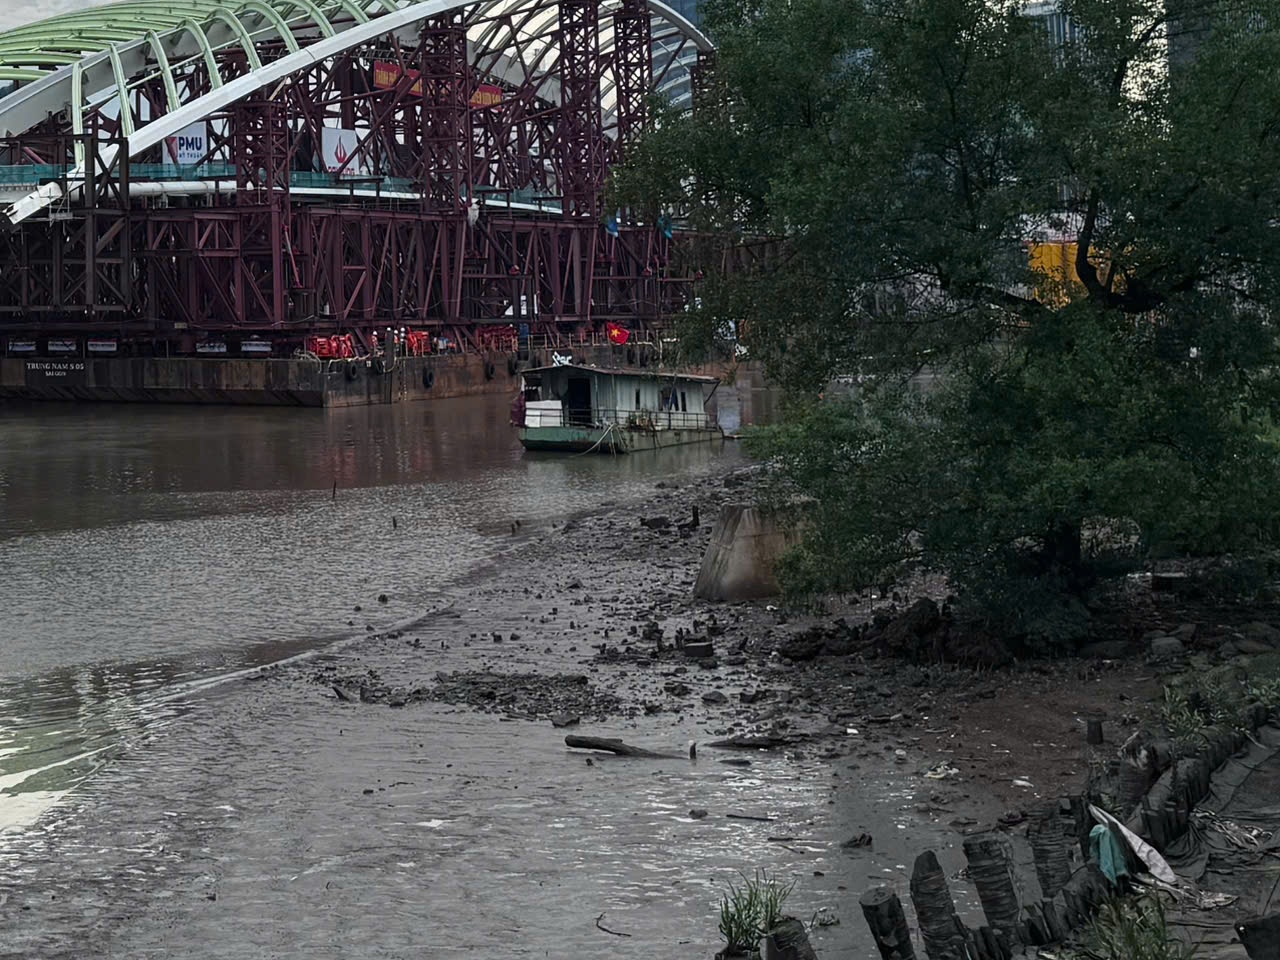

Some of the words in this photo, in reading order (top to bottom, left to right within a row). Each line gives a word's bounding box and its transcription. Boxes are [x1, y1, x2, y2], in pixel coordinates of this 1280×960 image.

[178, 136, 202, 151] PMU
[26, 362, 51, 370] TRUNG
[51, 362, 68, 370] NAM
